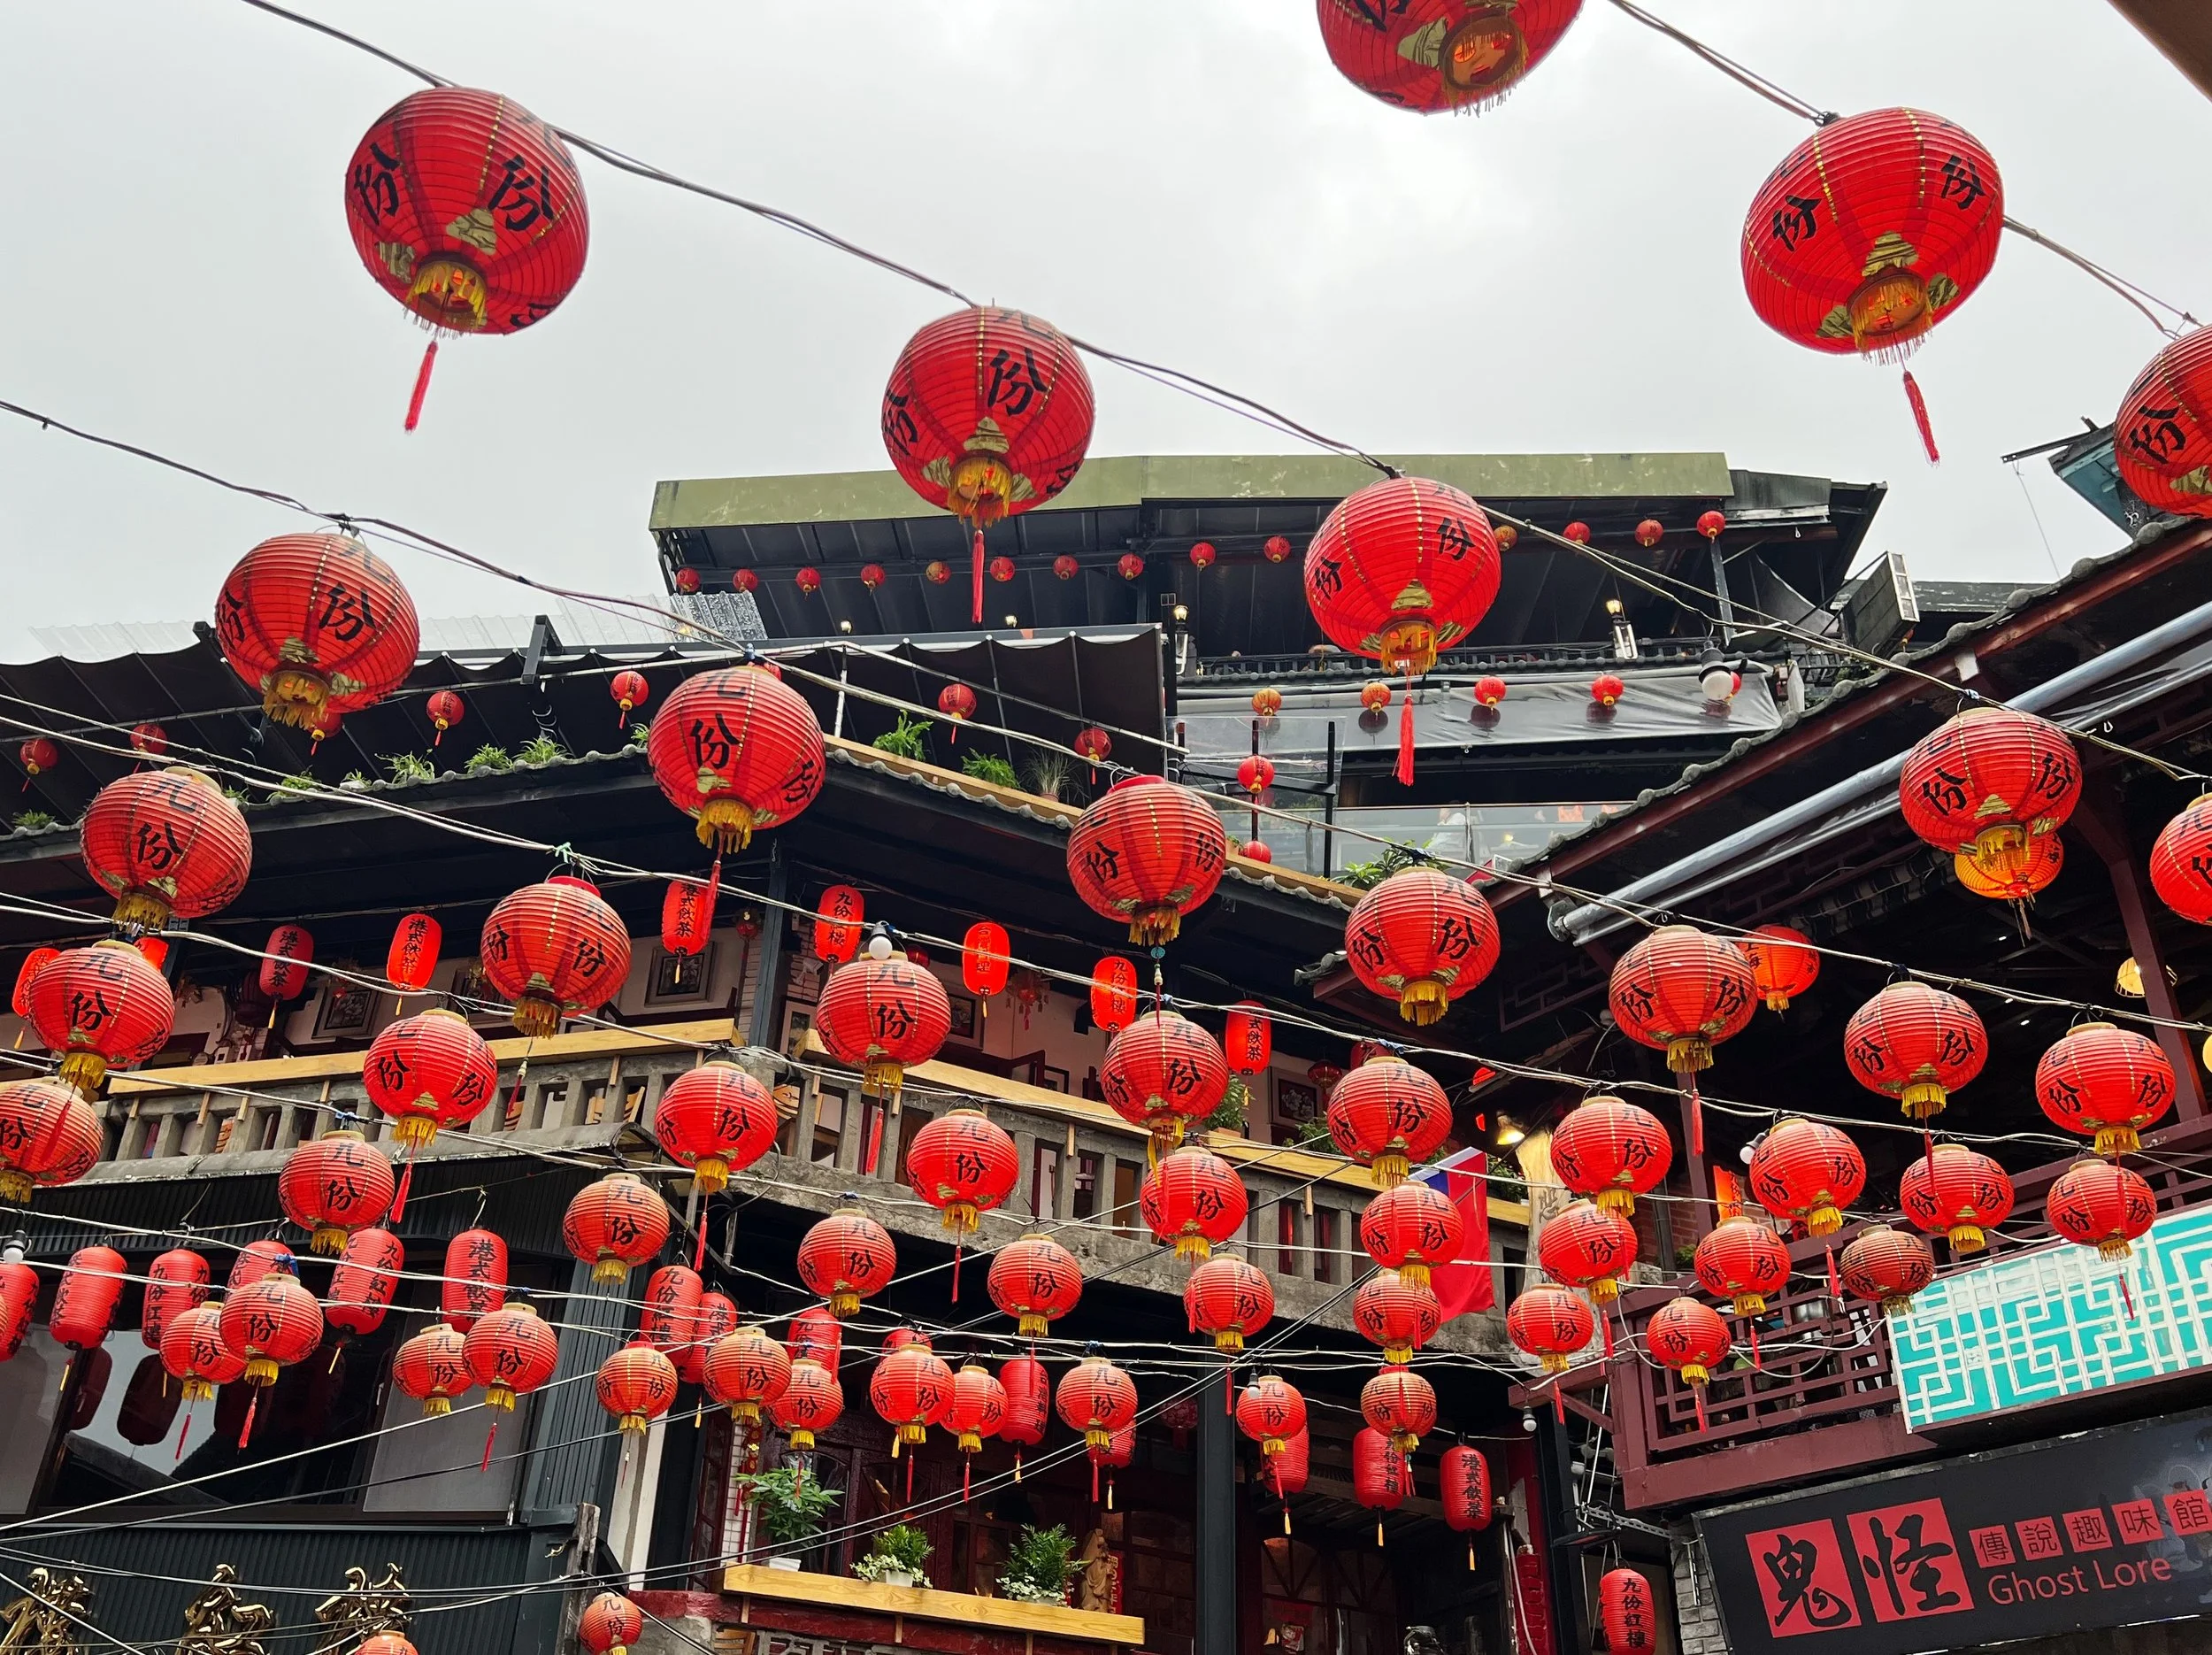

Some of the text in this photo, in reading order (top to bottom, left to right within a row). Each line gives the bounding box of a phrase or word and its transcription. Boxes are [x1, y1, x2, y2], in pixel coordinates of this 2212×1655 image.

[828, 891, 854, 948] 九份樓
[1462, 1454, 1483, 1519] 港式飲茶
[1979, 1497, 2209, 1563] 傳說趣味館
[1764, 1514, 1961, 1627] 鬼怪
[1988, 1558, 2172, 1605] Ghost Lore
[1621, 1578, 1646, 1648] 九份紅樓
